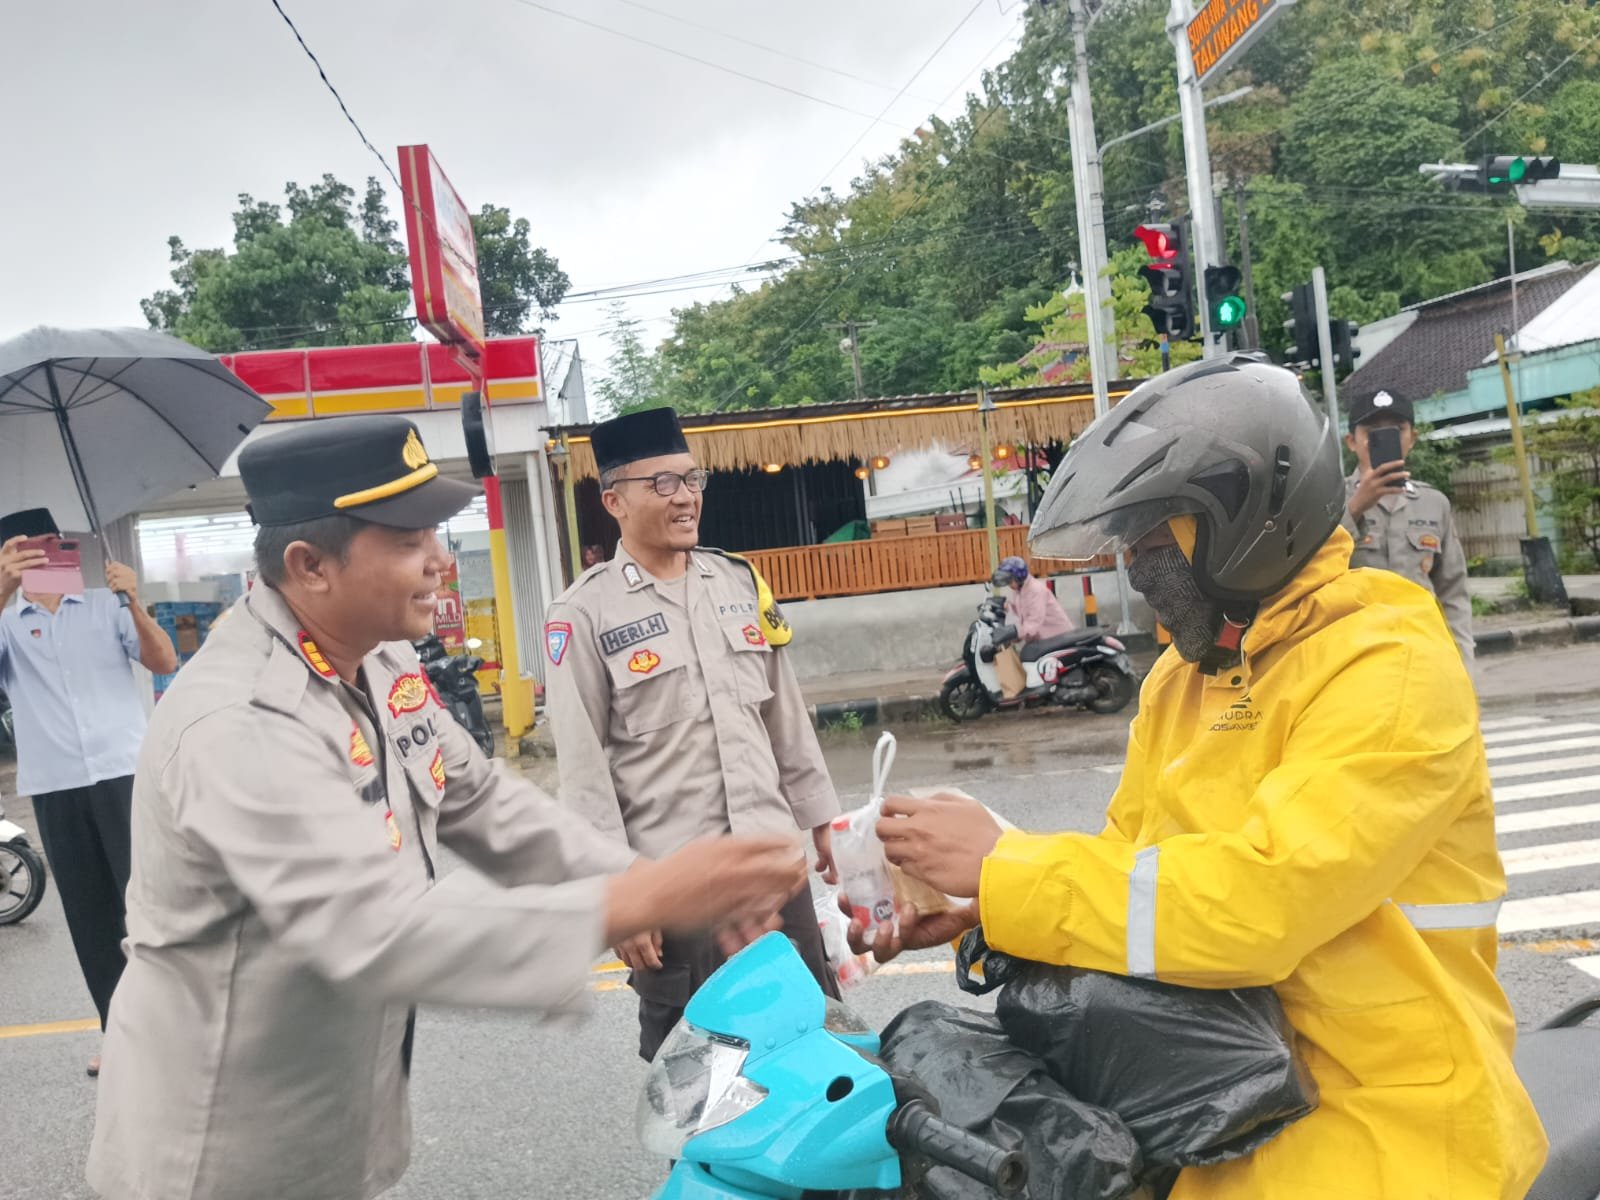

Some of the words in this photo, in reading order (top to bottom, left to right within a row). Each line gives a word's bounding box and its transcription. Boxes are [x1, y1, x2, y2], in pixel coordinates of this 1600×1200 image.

[1192, 0, 1259, 77] TALIWANG
[606, 617, 662, 649] HERI.H
[1219, 710, 1264, 721] UDRA
